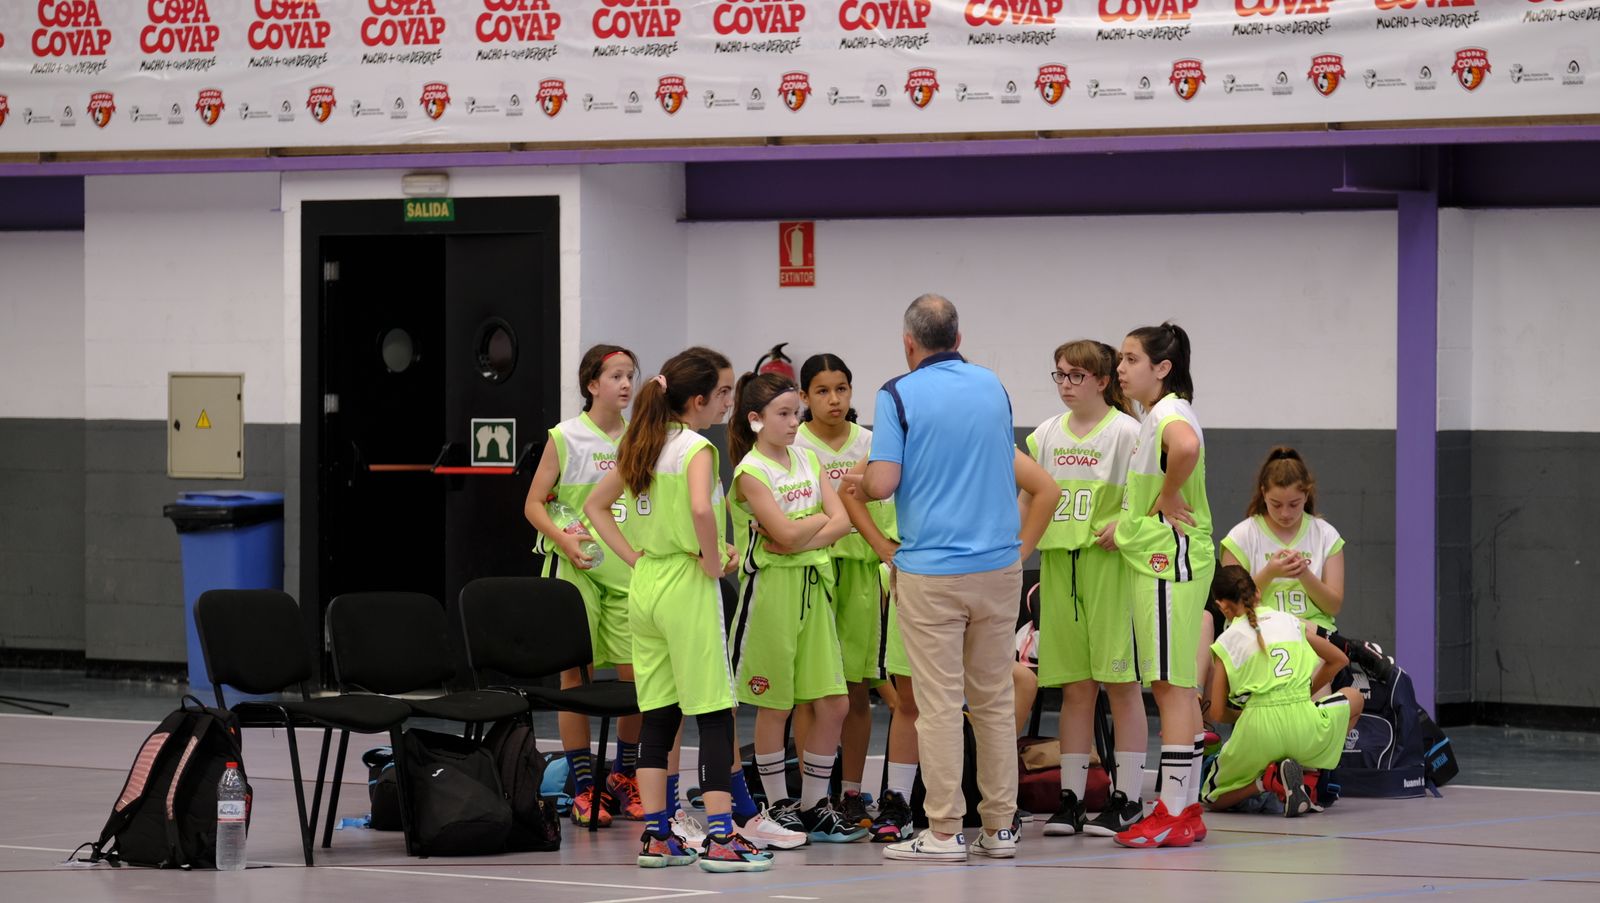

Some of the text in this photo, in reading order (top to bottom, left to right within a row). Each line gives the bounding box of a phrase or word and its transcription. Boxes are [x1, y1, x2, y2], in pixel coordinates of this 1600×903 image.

[38, 0, 102, 27] COPA
[147, 0, 210, 24] COPA
[254, 0, 320, 20] COPA
[592, 8, 682, 39] COVAP
[713, 3, 806, 35] COVAP
[838, 0, 932, 31] COVAP
[964, 0, 1063, 27] COVAP
[140, 25, 220, 54] COVAP
[248, 21, 331, 51] COVAP
[361, 16, 446, 47] COVAP
[476, 12, 561, 43] COVAP
[32, 28, 112, 57] COVAP
[1174, 69, 1201, 79] COVAP
[1313, 65, 1340, 75] COVAP
[1457, 58, 1486, 68] COVAP
[407, 202, 449, 217] SALIDA
[1053, 446, 1102, 459] Muévete
[1057, 455, 1098, 467] COVAP
[1053, 488, 1092, 522] 20
[1275, 590, 1307, 614] 19
[1270, 648, 1293, 677] 2
